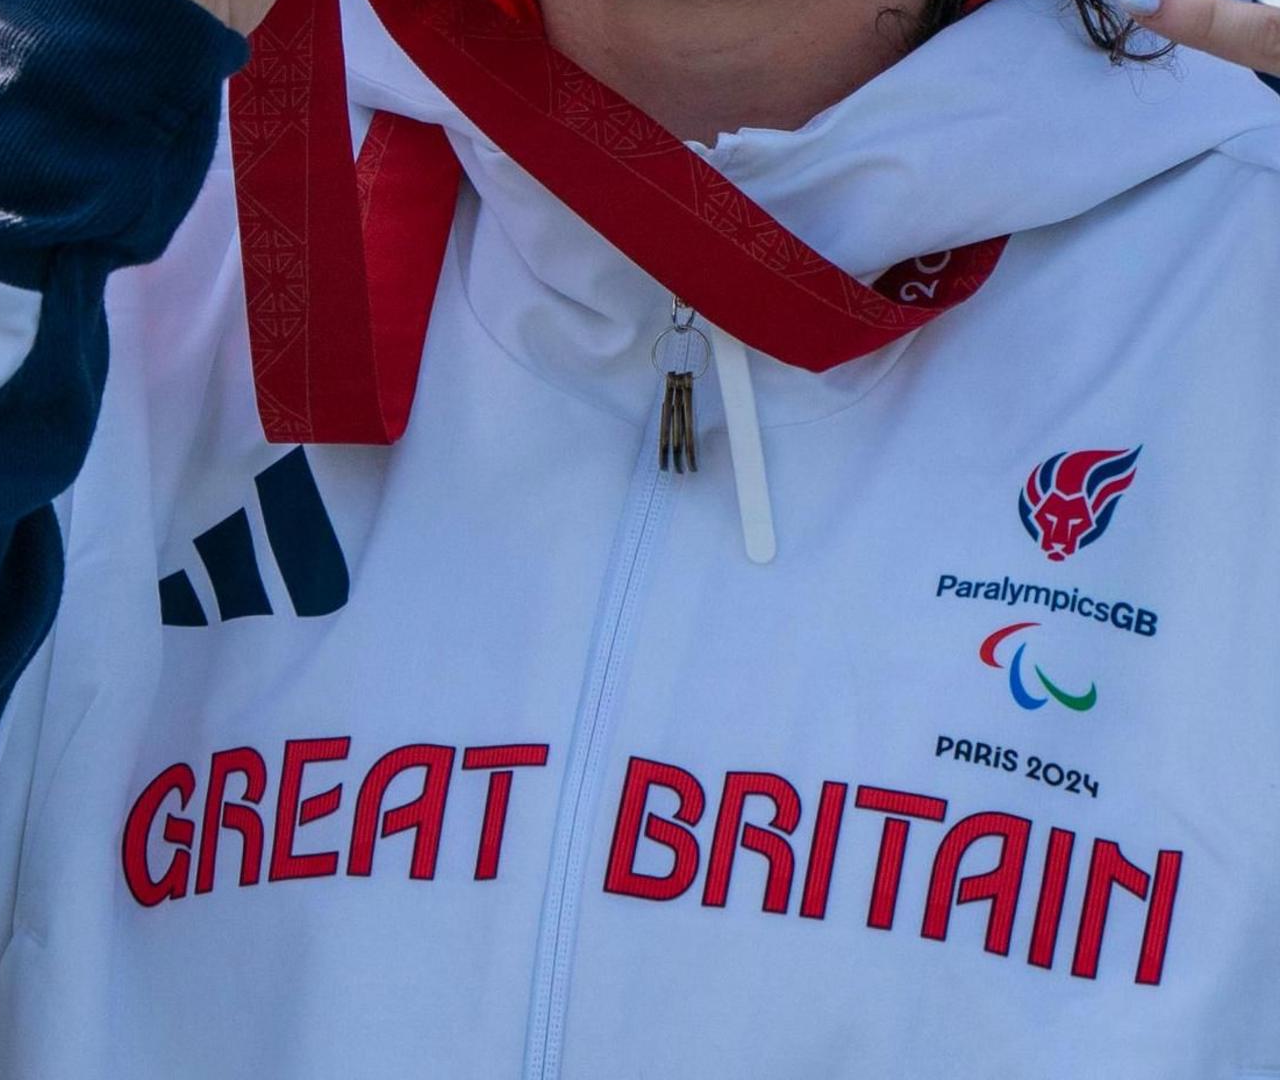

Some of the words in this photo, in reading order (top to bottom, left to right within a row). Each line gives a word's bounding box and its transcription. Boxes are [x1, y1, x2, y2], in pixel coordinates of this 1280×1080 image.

[936, 574, 1158, 637] ParalympicsGB
[1026, 756, 1099, 798] 2024
[122, 736, 549, 907] GREAT
[603, 756, 1183, 986] BRITAIN
